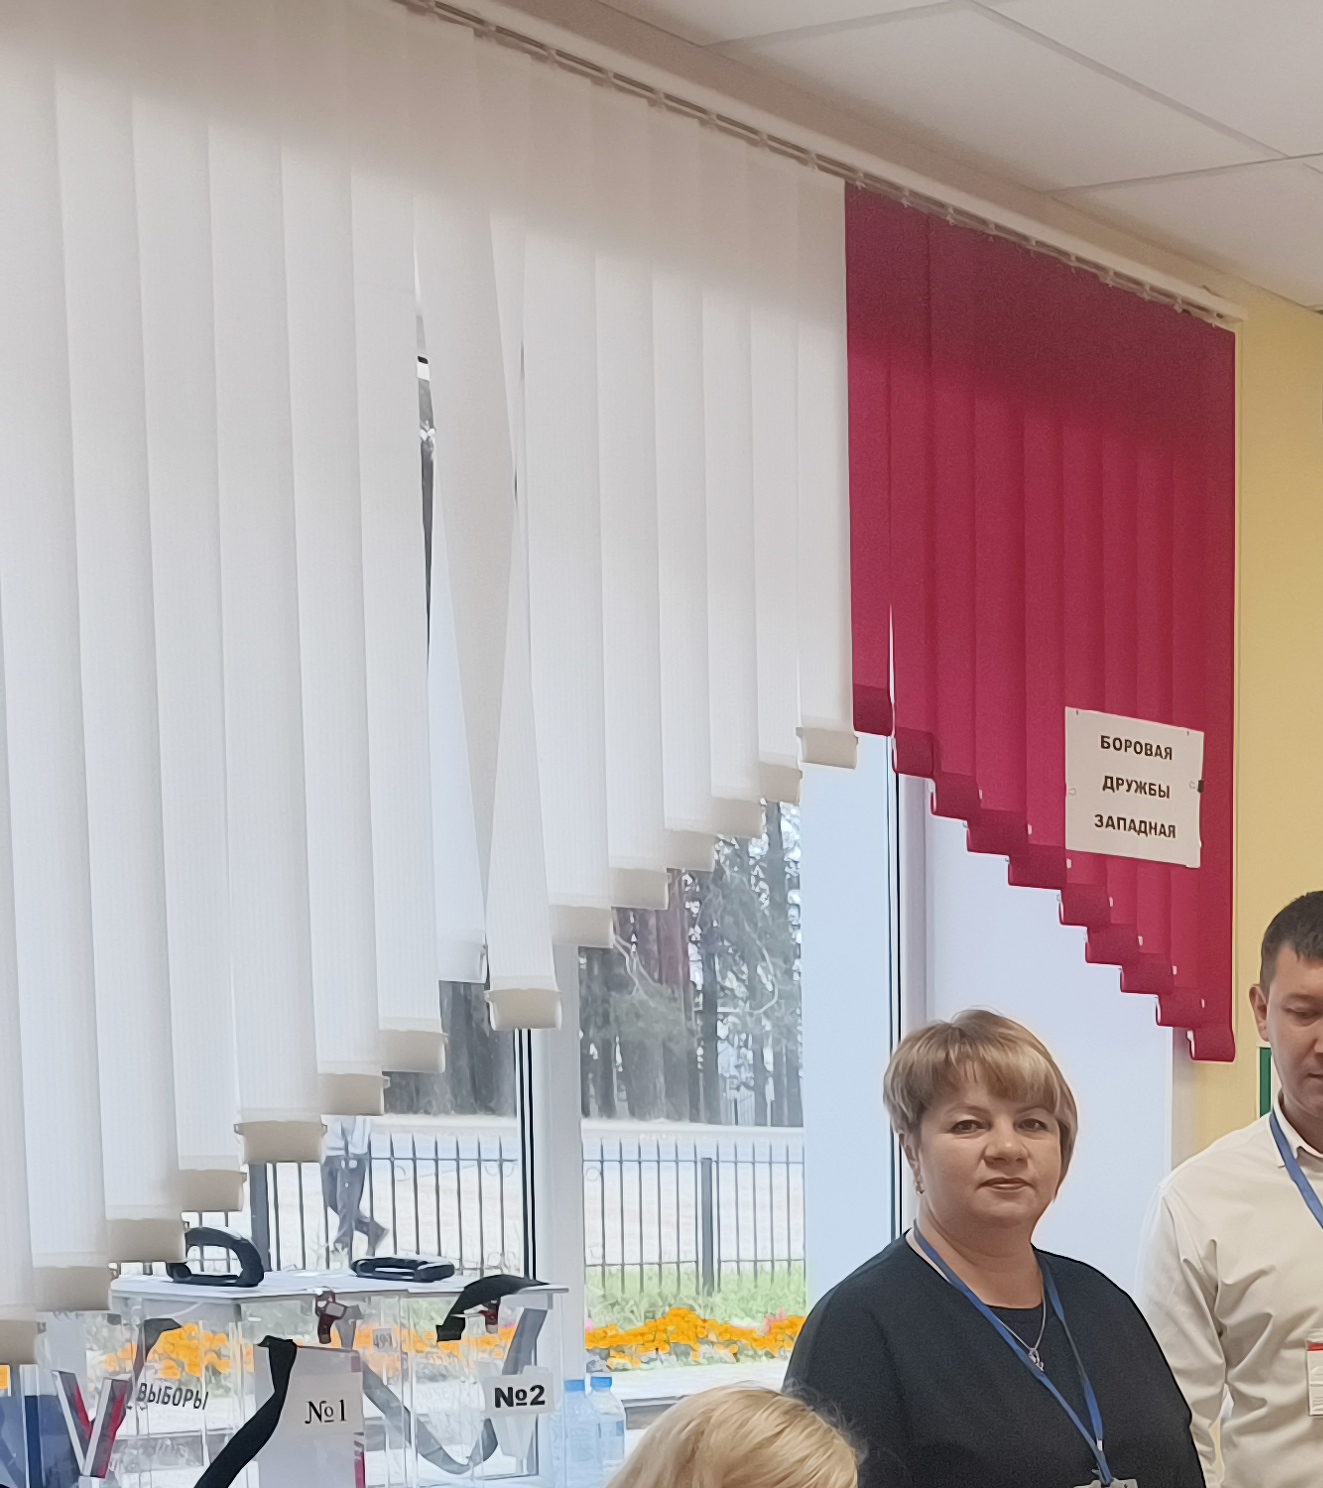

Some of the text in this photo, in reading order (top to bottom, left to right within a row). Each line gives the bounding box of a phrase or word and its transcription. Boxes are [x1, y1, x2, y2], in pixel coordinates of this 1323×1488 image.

[1100, 735, 1173, 760] БОРОВАЯ
[1102, 775, 1170, 799] ДРУЖБЫ
[1094, 814, 1176, 839] ЗАПАДНАЯ
[137, 1382, 209, 1411] ВЫБОРЫ
[495, 1385, 546, 1408] №2
[305, 1399, 347, 1424] №1
